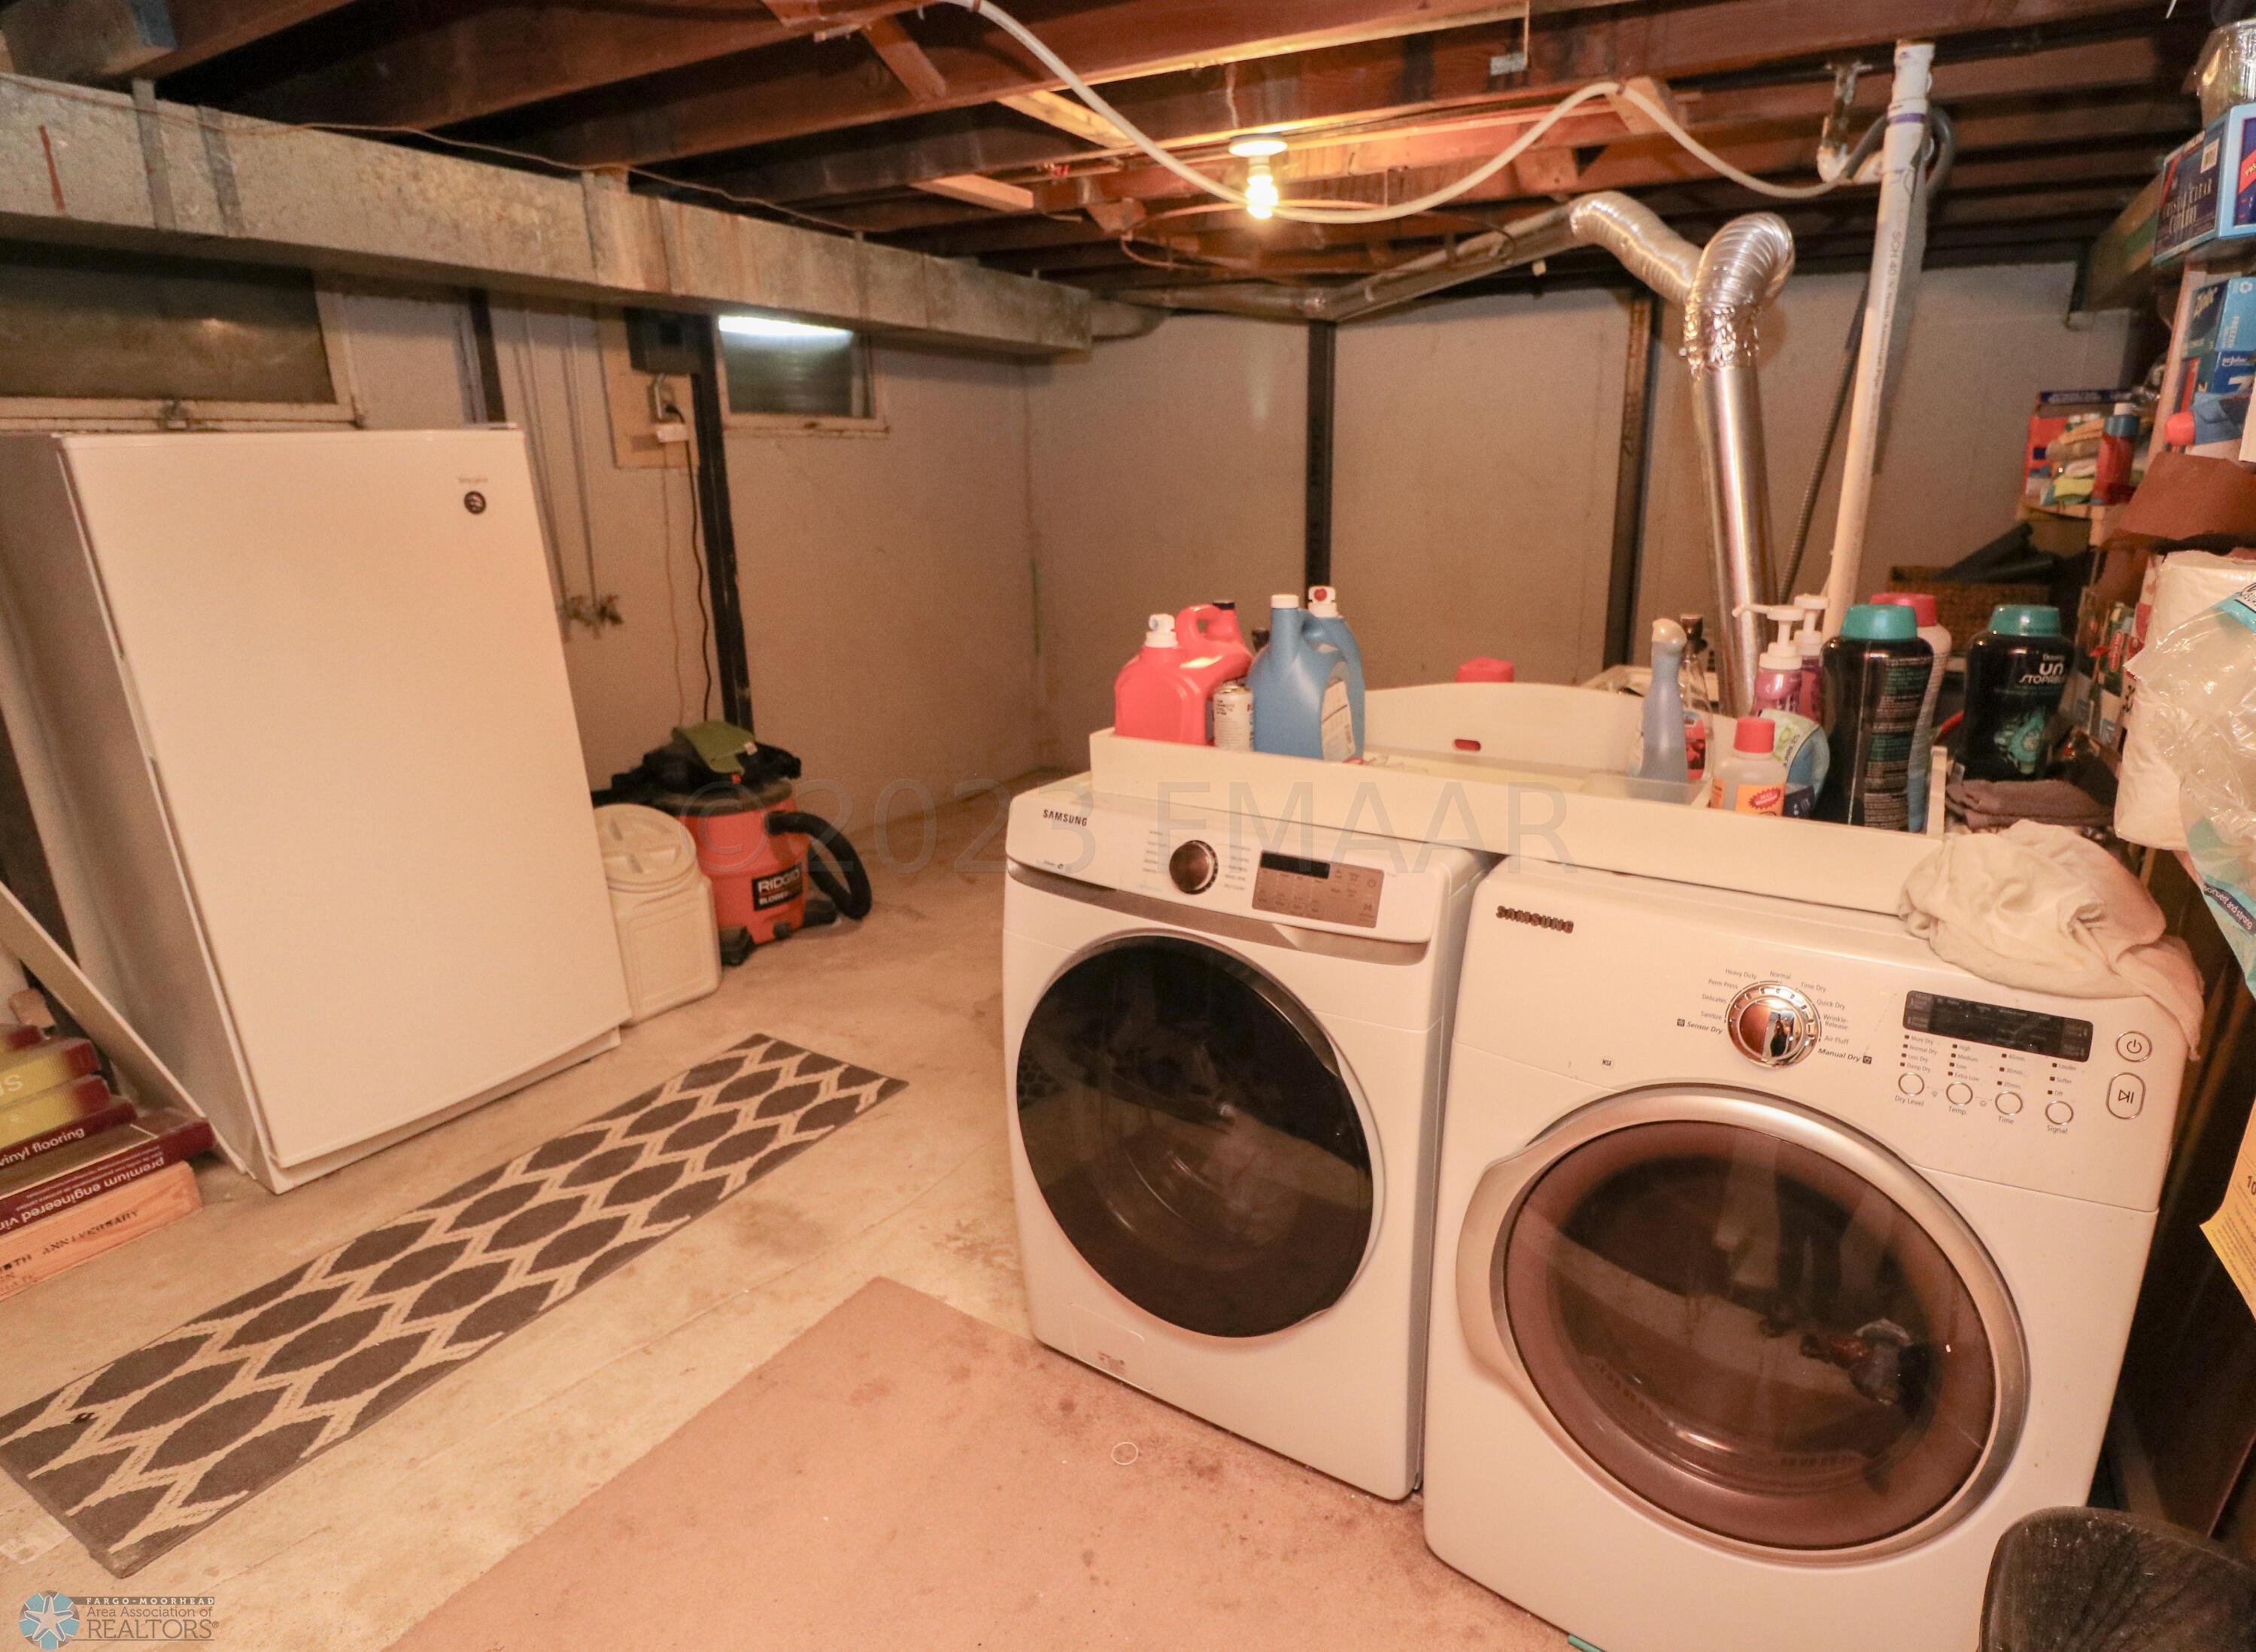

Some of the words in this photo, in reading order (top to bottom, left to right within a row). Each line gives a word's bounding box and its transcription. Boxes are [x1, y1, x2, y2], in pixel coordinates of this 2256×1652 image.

[1043, 809, 1088, 827] SAMSUNG
[758, 868, 800, 893] RIDGID
[1495, 905, 1574, 934] SAMSUNG
[1725, 969, 1743, 978] Heavy
[1743, 971, 1757, 980] Duty
[1769, 970, 1791, 979] Normal
[1708, 979, 1723, 987] Perm
[1723, 982, 1738, 990] Press
[1801, 982, 1815, 990] Time
[1816, 984, 1827, 993] Dry
[1702, 994, 1727, 1004] Delicates
[1817, 999, 1833, 1007] Quick
[1835, 1002, 1846, 1010] Dry
[1700, 1011, 1723, 1020] Sanitize
[1687, 1021, 1710, 1031] Sensor
[1710, 1025, 1723, 1034] Dry
[1835, 1037, 1849, 1045] Fluff
[1817, 1048, 1846, 1058] Manual
[1847, 1054, 1861, 1063] Dry
[1894, 1095, 1906, 1104] Dry
[1907, 1098, 1924, 1107] Level
[1997, 1116, 2015, 1125] Time
[2046, 1125, 2069, 1134] Signal
[0, 1146, 29, 1166] vinyl
[32, 1128, 85, 1152] flooring
[104, 1156, 165, 1186] premium
[23, 1182, 101, 1223] engineered
